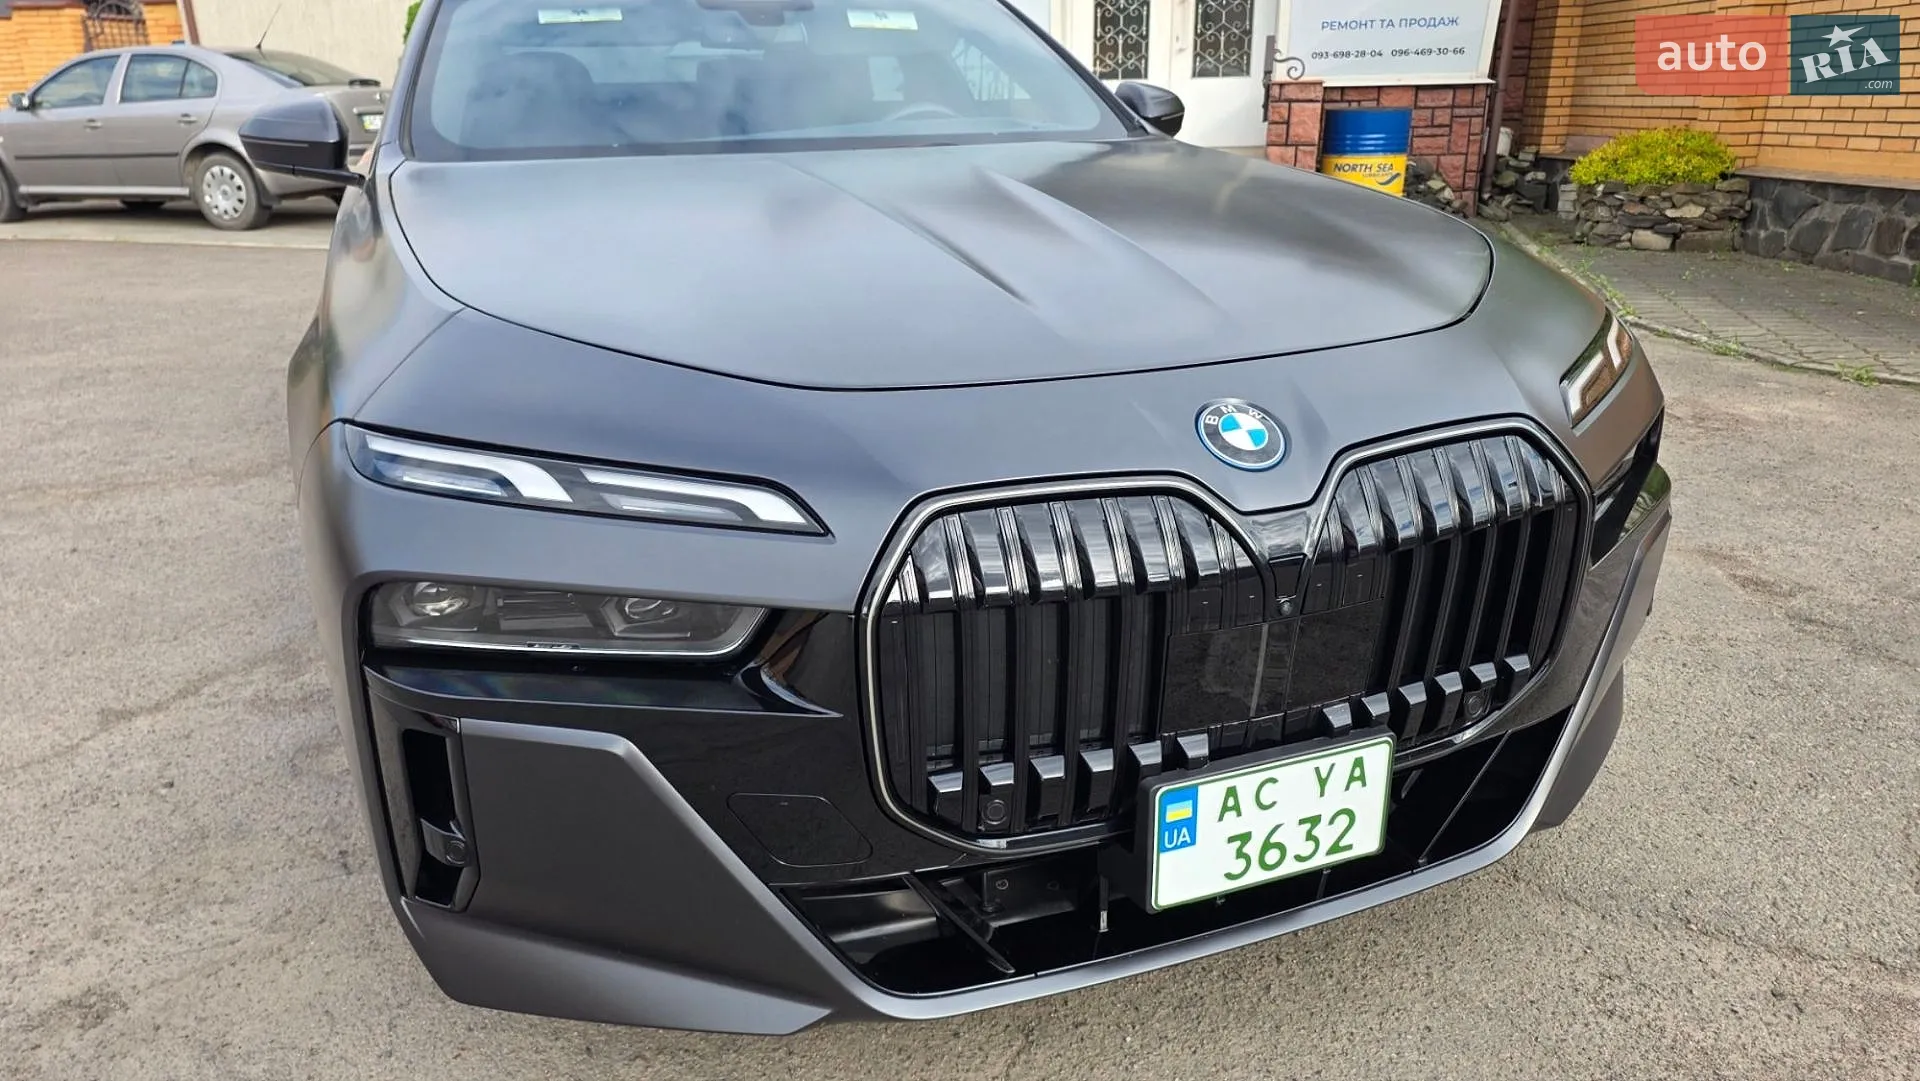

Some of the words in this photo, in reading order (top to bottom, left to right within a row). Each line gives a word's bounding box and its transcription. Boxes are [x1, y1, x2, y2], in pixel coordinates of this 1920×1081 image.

[1321, 19, 1376, 31] РЕМОНТ
[1380, 19, 1395, 29] ТА
[1400, 16, 1460, 29] ПРОДАЖ
[1311, 49, 1383, 60] 093-698-28-04
[1391, 47, 1466, 57] 096-469-30-66
[1333, 163, 1373, 173] NORTH
[1376, 162, 1394, 172] SEA
[1205, 405, 1264, 425] BMW
[1217, 776, 1279, 822] AC
[1314, 756, 1367, 798] YA
[1164, 827, 1191, 848] UA
[1224, 808, 1357, 881] 3632
